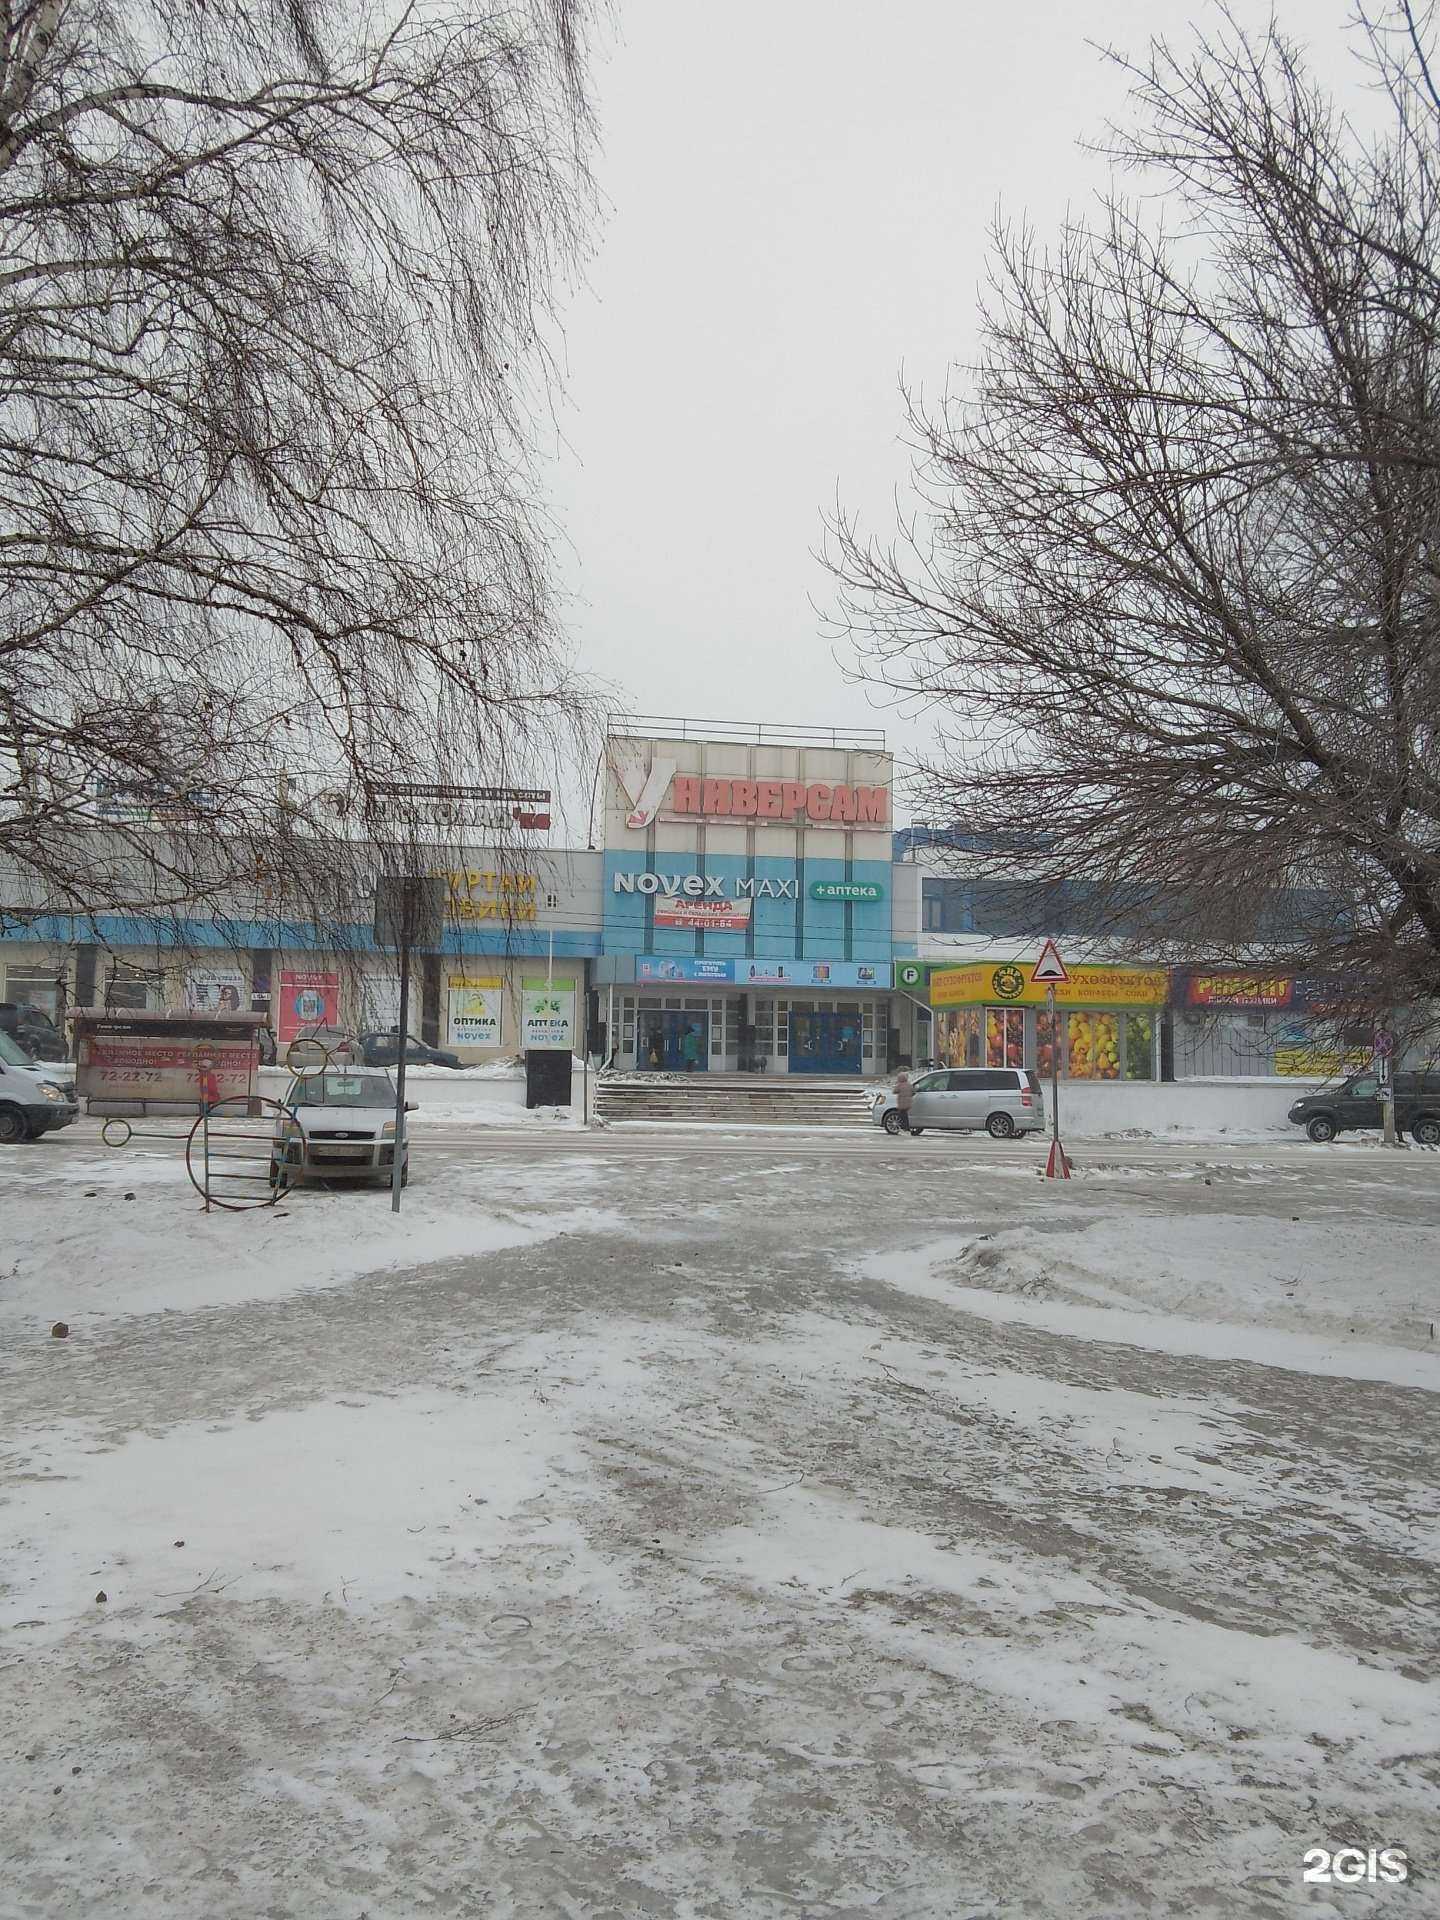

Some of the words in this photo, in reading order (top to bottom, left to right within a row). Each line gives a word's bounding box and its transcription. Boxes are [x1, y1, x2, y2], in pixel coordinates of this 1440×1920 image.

[613, 757, 888, 830] УНИВЕРСАМ
[735, 877, 800, 899] MAXI
[453, 1017, 497, 1026] ОПТИКА
[527, 1019, 569, 1027] АПТЕКА
